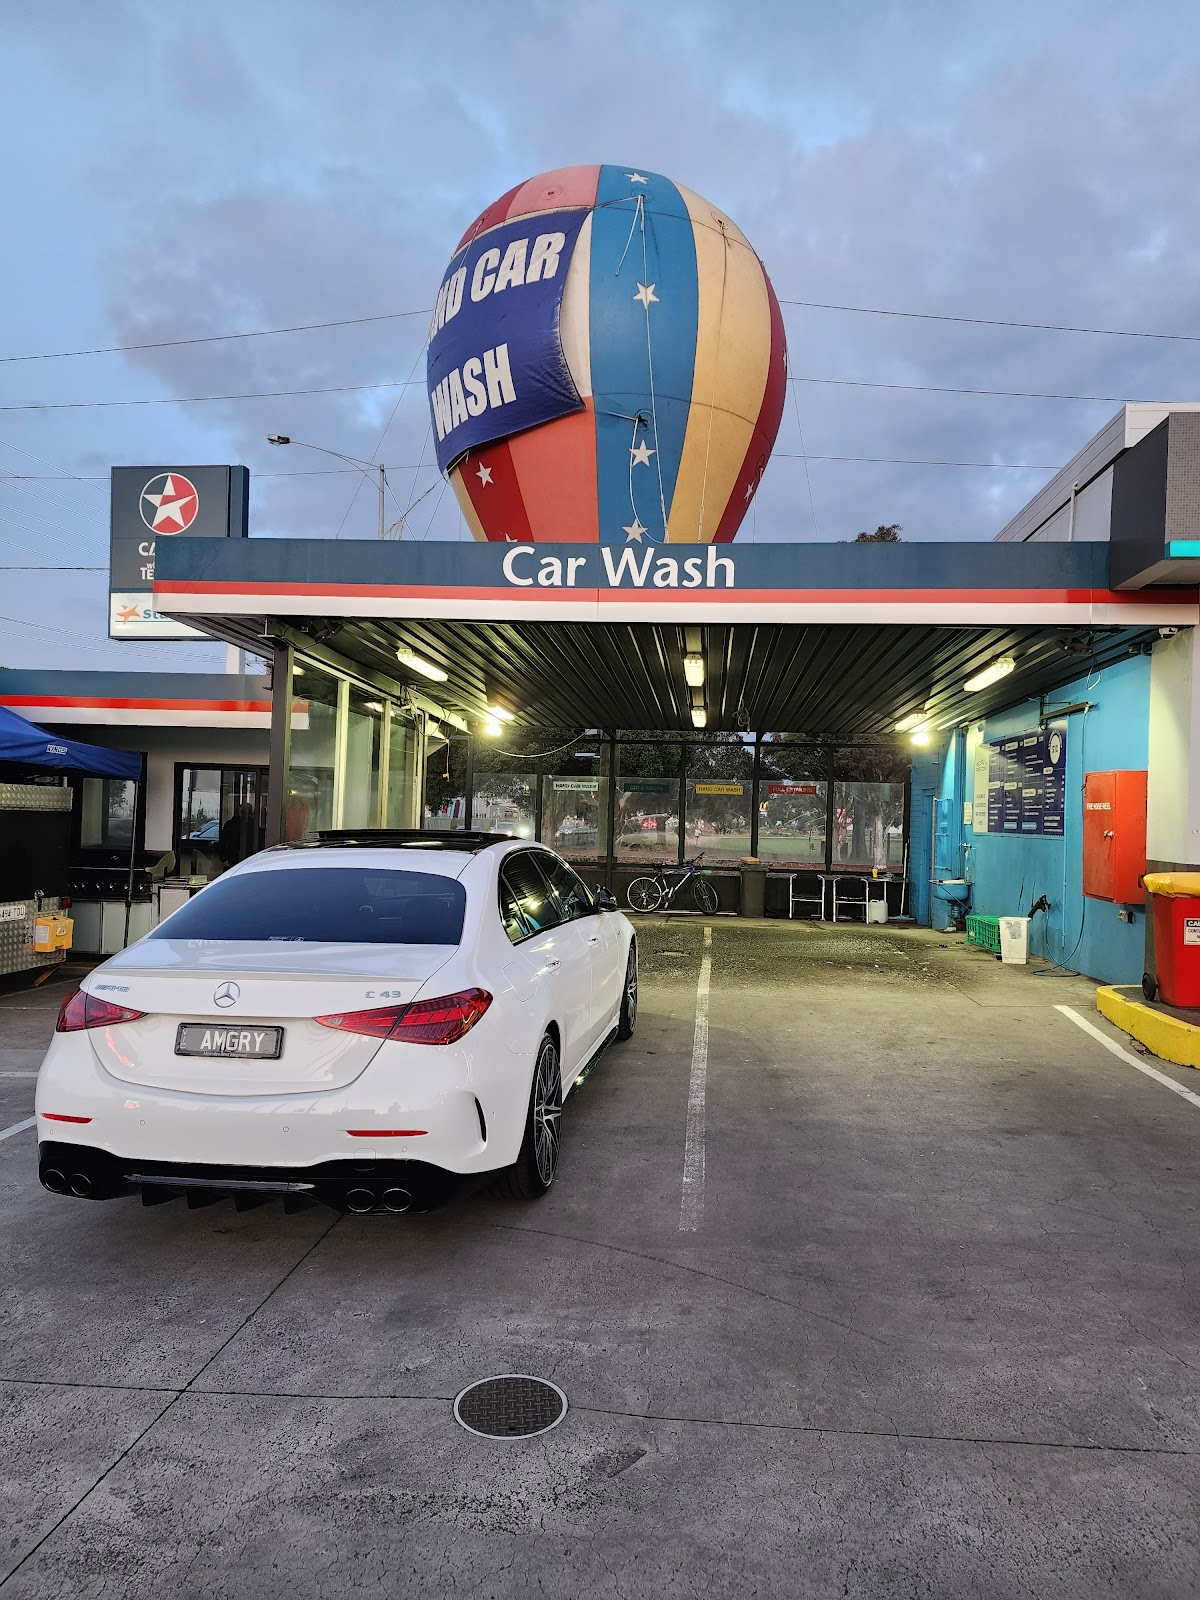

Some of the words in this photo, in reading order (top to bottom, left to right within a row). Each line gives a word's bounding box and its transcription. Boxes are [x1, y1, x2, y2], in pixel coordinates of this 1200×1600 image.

[471, 232, 566, 302] CAR
[431, 343, 517, 442] WASH
[502, 545, 587, 587] Car
[601, 545, 735, 588] Wash
[365, 990, 376, 999] C
[379, 990, 401, 999] 43
[199, 1030, 266, 1052] AMGRY
